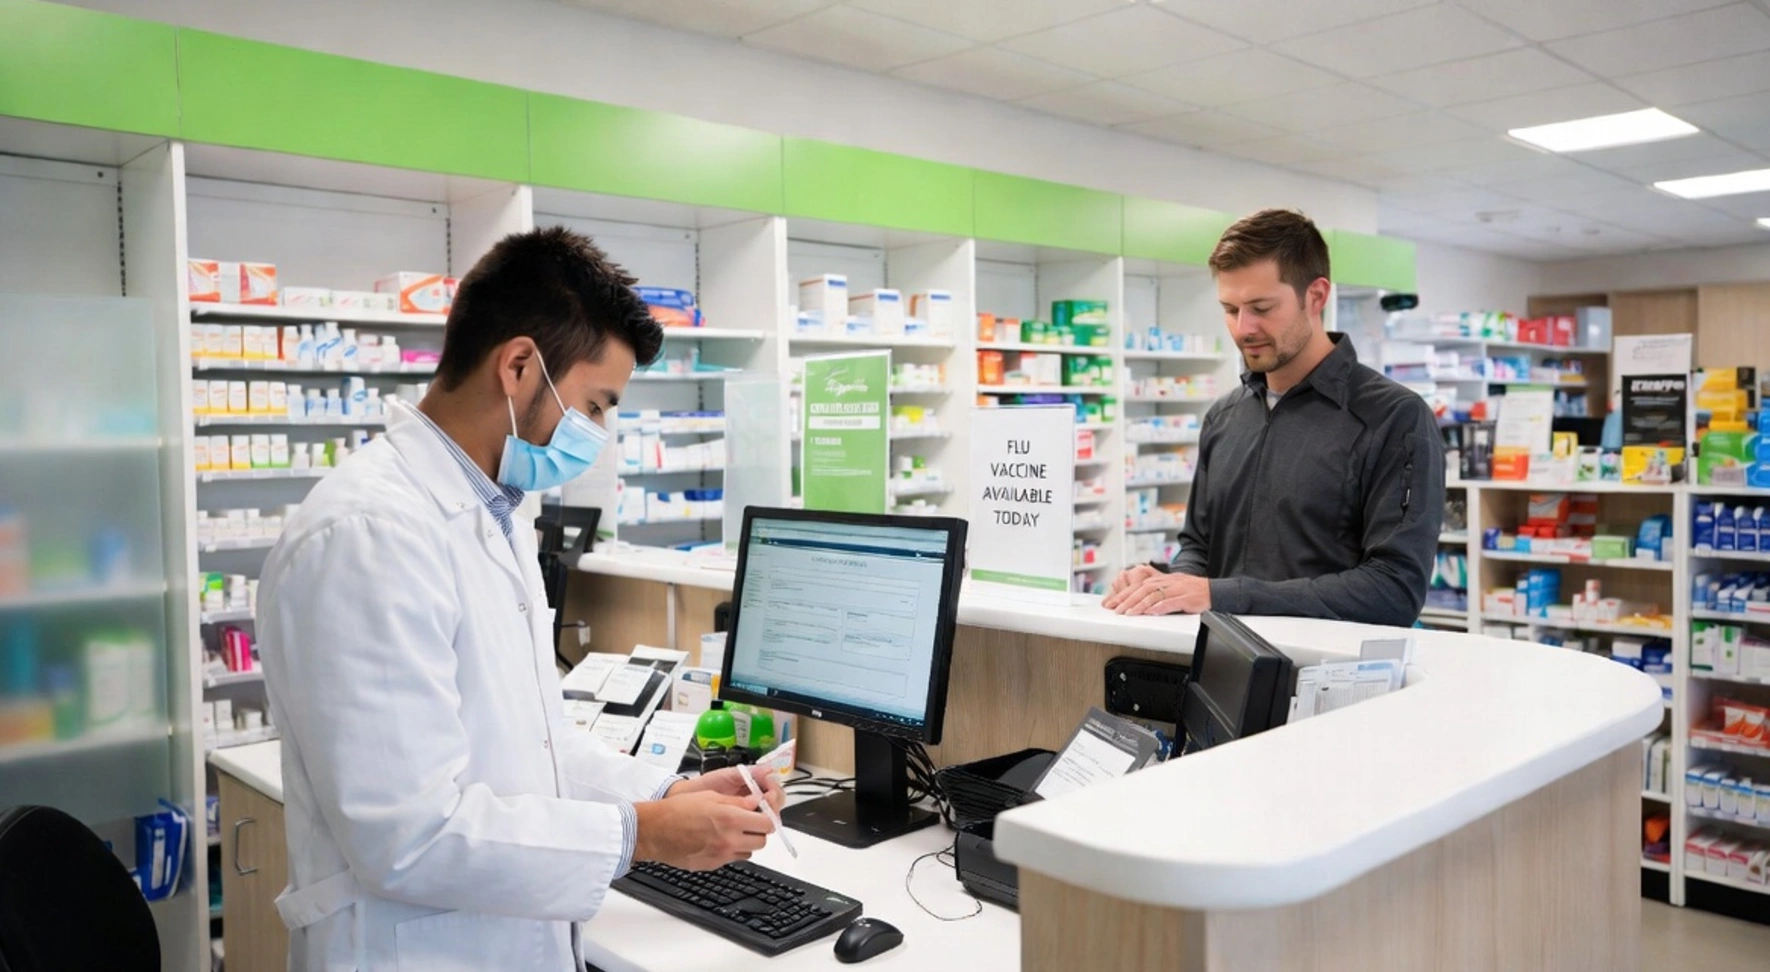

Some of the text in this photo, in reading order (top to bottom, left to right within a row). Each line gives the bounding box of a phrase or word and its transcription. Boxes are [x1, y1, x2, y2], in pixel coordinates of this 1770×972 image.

[1007, 440, 1030, 455] FLU
[990, 463, 1046, 478] VACCINE
[982, 486, 1053, 504] AVAILABLE
[994, 510, 1040, 527] TODAY
